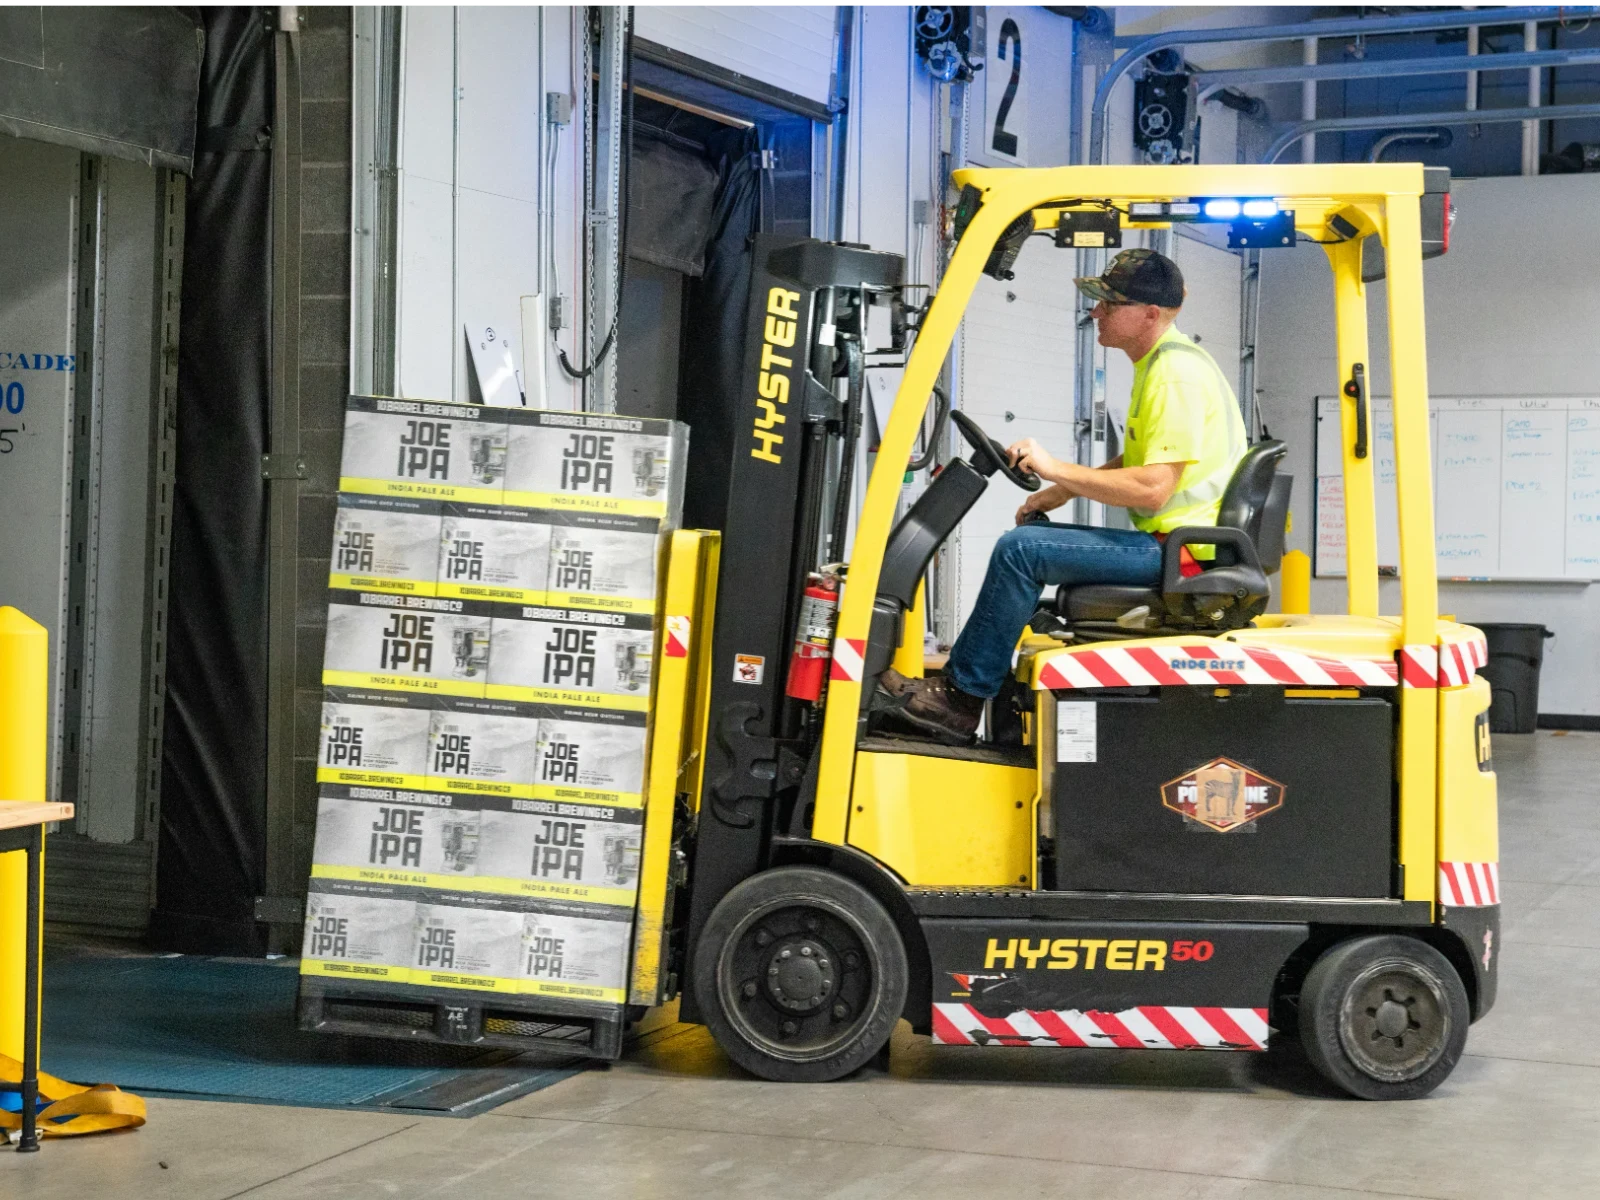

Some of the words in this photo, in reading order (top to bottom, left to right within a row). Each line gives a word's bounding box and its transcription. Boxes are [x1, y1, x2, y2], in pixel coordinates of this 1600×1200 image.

[992, 18, 1021, 157] 2
[751, 287, 800, 464] HYSTER
[400, 420, 451, 447] JOE
[564, 433, 614, 460] JOE
[398, 446, 450, 480] IPA
[561, 459, 612, 493] IPA
[388, 484, 412, 492] INDIA
[416, 486, 436, 494] PALE
[551, 497, 576, 505] INDIA
[340, 531, 374, 549] JOE
[449, 540, 484, 558] JOE
[337, 549, 372, 572] IPA
[447, 558, 482, 580] IPA
[558, 550, 593, 568] JOE
[556, 568, 591, 590] IPA
[384, 613, 435, 640] JOE
[546, 628, 597, 654] JOE
[381, 639, 433, 672] IPA
[1171, 659, 1206, 670] RIDE
[543, 653, 595, 686] IPA
[370, 676, 395, 684] INDIA
[399, 679, 420, 687] PALE
[533, 691, 558, 699] INDIA
[562, 694, 582, 702] PALE
[328, 726, 363, 744] JOE
[436, 734, 471, 752] JOE
[326, 744, 361, 766] IPA
[545, 742, 579, 761] JOE
[434, 752, 470, 774] IPA
[542, 760, 577, 783] IPA
[372, 807, 424, 835] JOE
[534, 820, 586, 848] JOE
[369, 833, 422, 867] IPA
[531, 846, 583, 880] IPA
[360, 870, 384, 879] INDIA
[388, 873, 408, 882] PALE
[521, 883, 546, 892] INDIA
[550, 886, 570, 894] PALE
[573, 888, 588, 896] ALE
[313, 917, 348, 935] JOE
[421, 928, 456, 946] JOE
[311, 934, 346, 957] IPA
[418, 945, 454, 968] IPA
[530, 936, 564, 955] JOE
[984, 938, 1168, 970] HYSTER
[1171, 940, 1214, 962] 50
[527, 954, 562, 978] IPA
